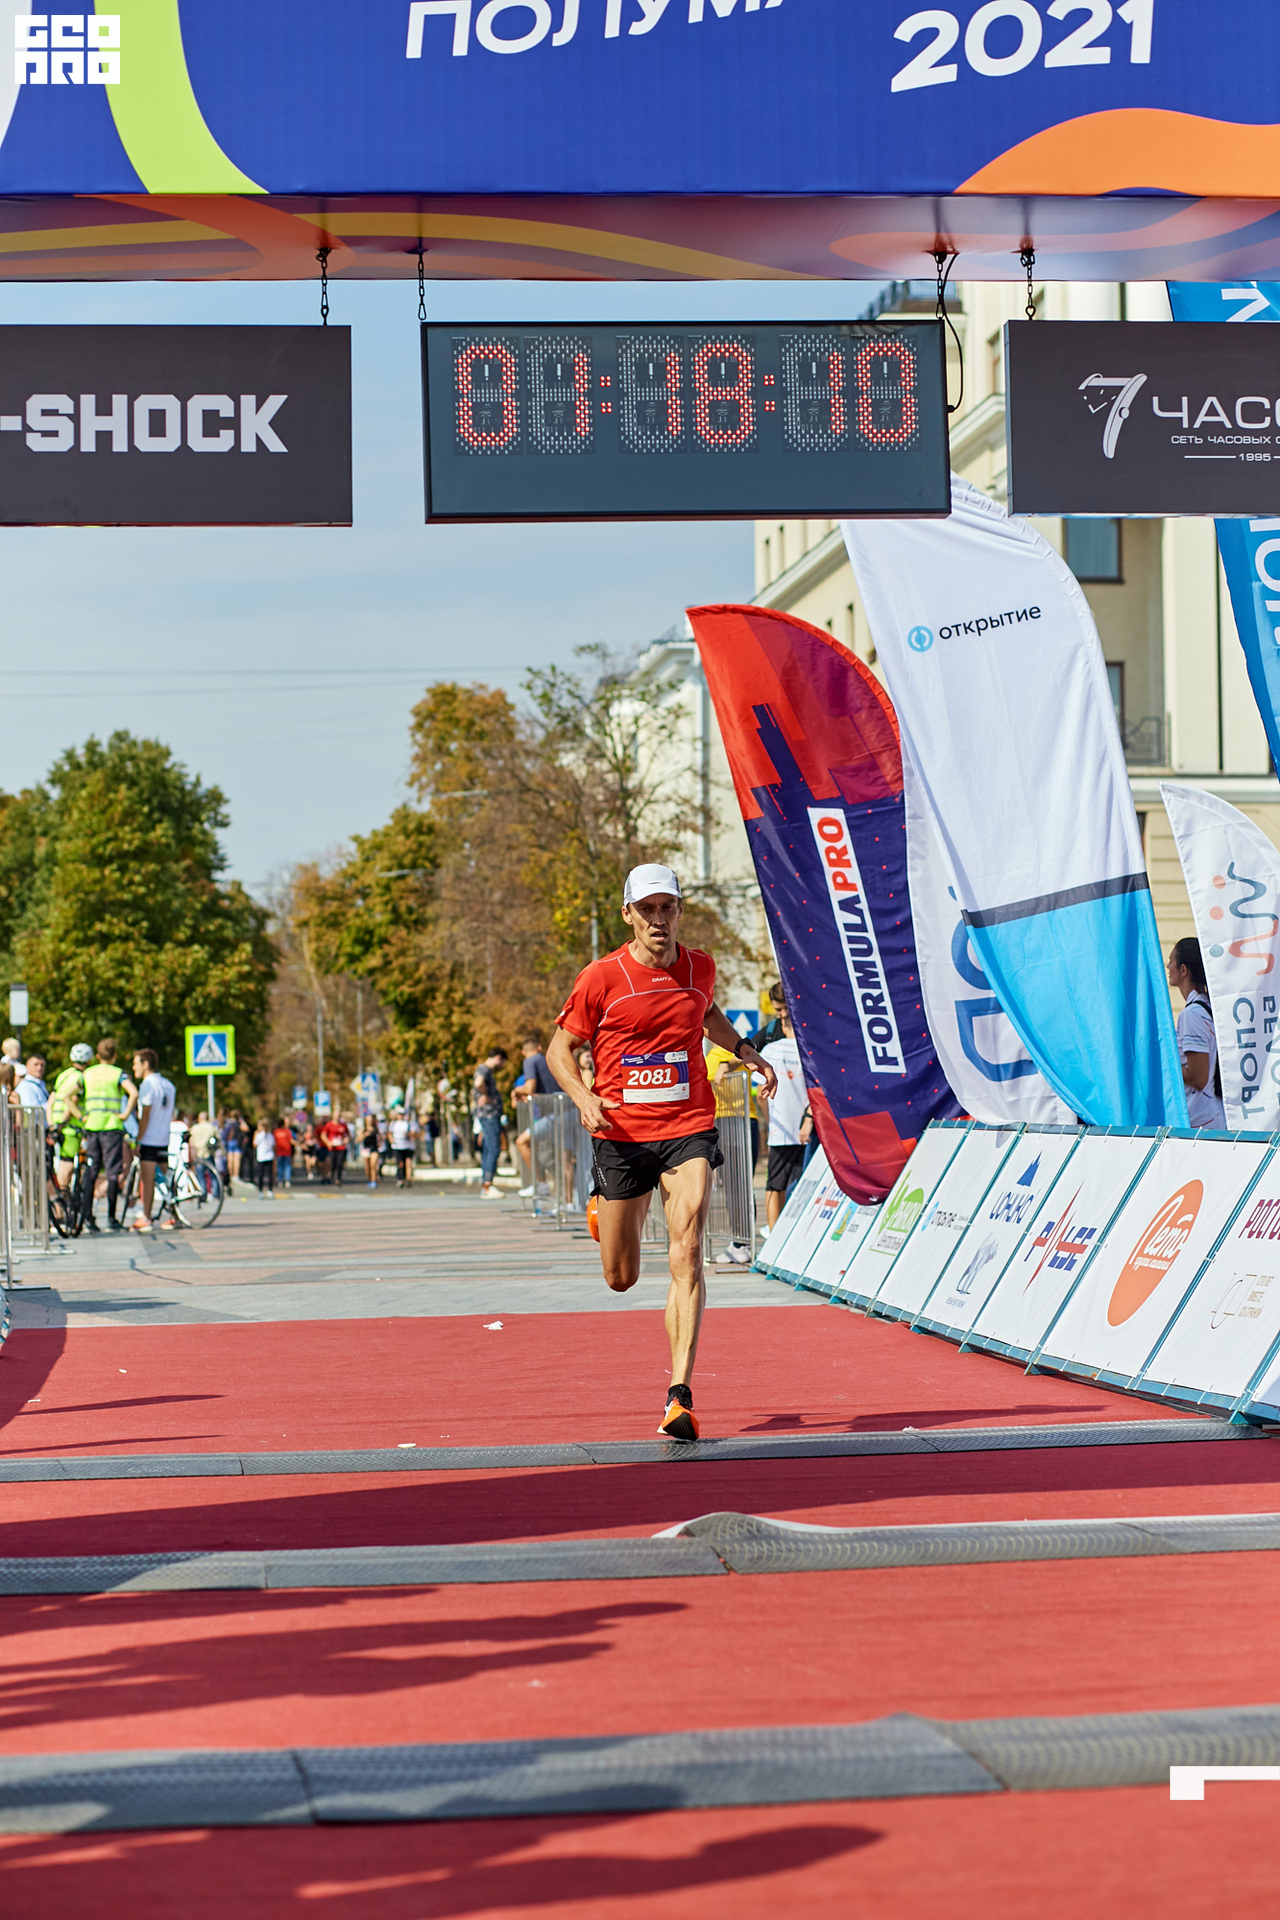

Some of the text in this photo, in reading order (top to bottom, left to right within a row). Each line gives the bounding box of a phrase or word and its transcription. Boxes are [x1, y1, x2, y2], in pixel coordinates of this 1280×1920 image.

[891, 0, 1154, 93] 2021
[458, 343, 916, 446] 01:18:10
[1152, 396, 1280, 429] ЧАС
[1171, 435, 1203, 444] СЕТЬ
[1208, 435, 1271, 444] ЧАСОВЫХ
[1239, 453, 1271, 461] 1995
[939, 606, 1041, 640] открытие
[627, 1068, 672, 1086] 2081
